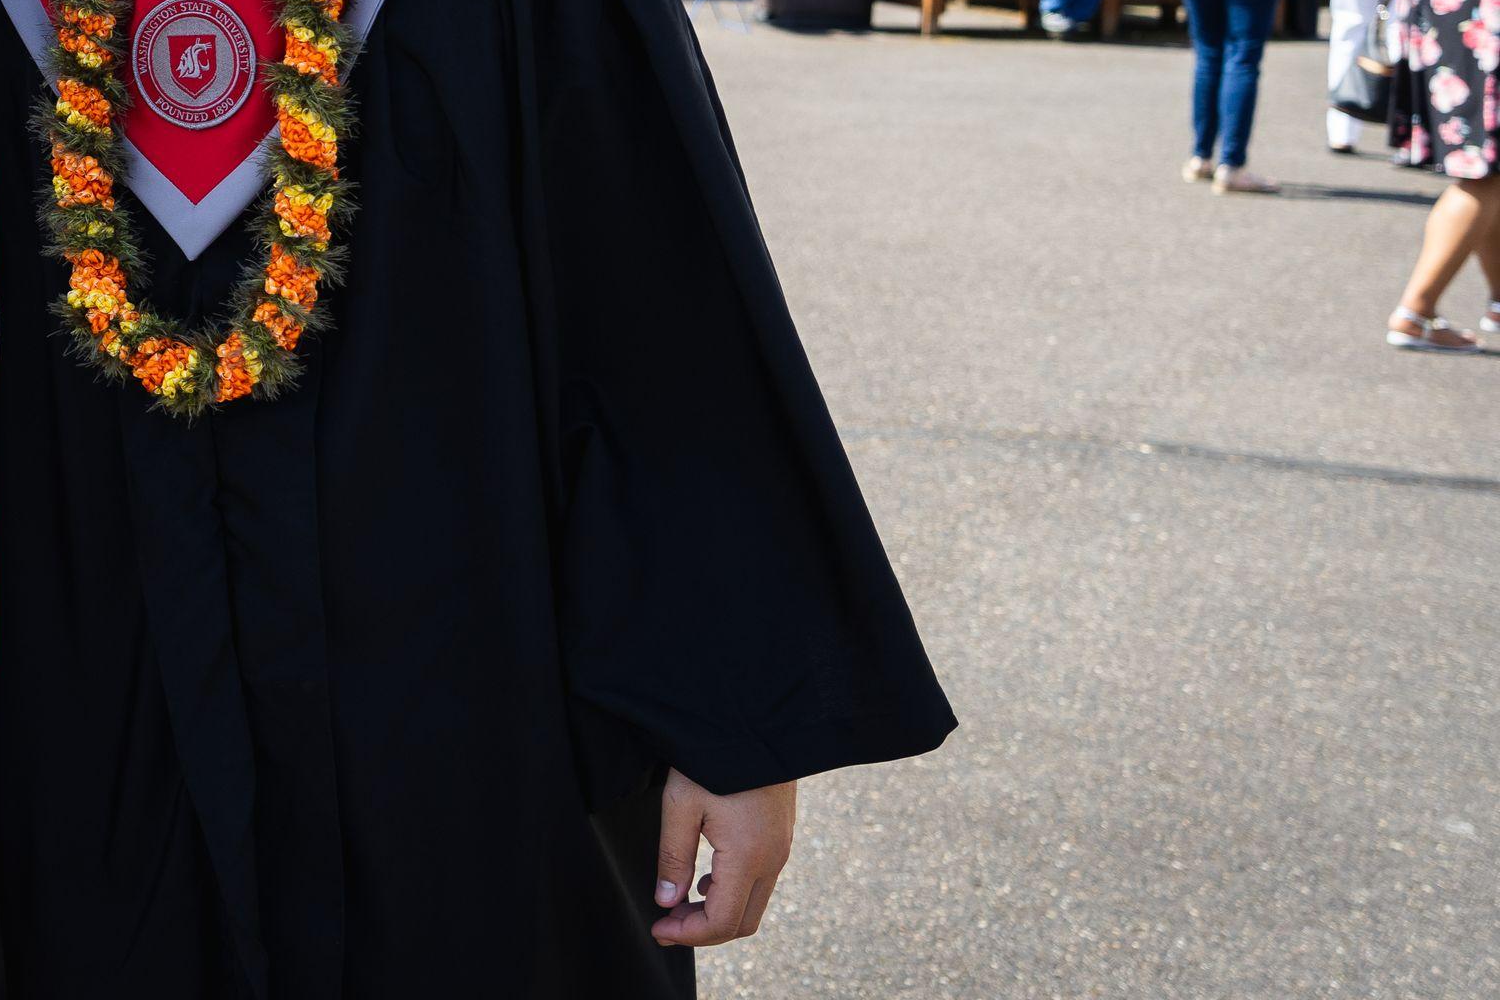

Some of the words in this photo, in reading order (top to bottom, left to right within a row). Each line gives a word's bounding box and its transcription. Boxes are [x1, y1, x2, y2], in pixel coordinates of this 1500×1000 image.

[138, 5, 177, 75] WASHINGTON
[180, 1, 213, 14] STATE
[215, 10, 250, 73] UNIVERSITY
[154, 97, 209, 122] FOUNDED
[213, 97, 234, 118] 1890
